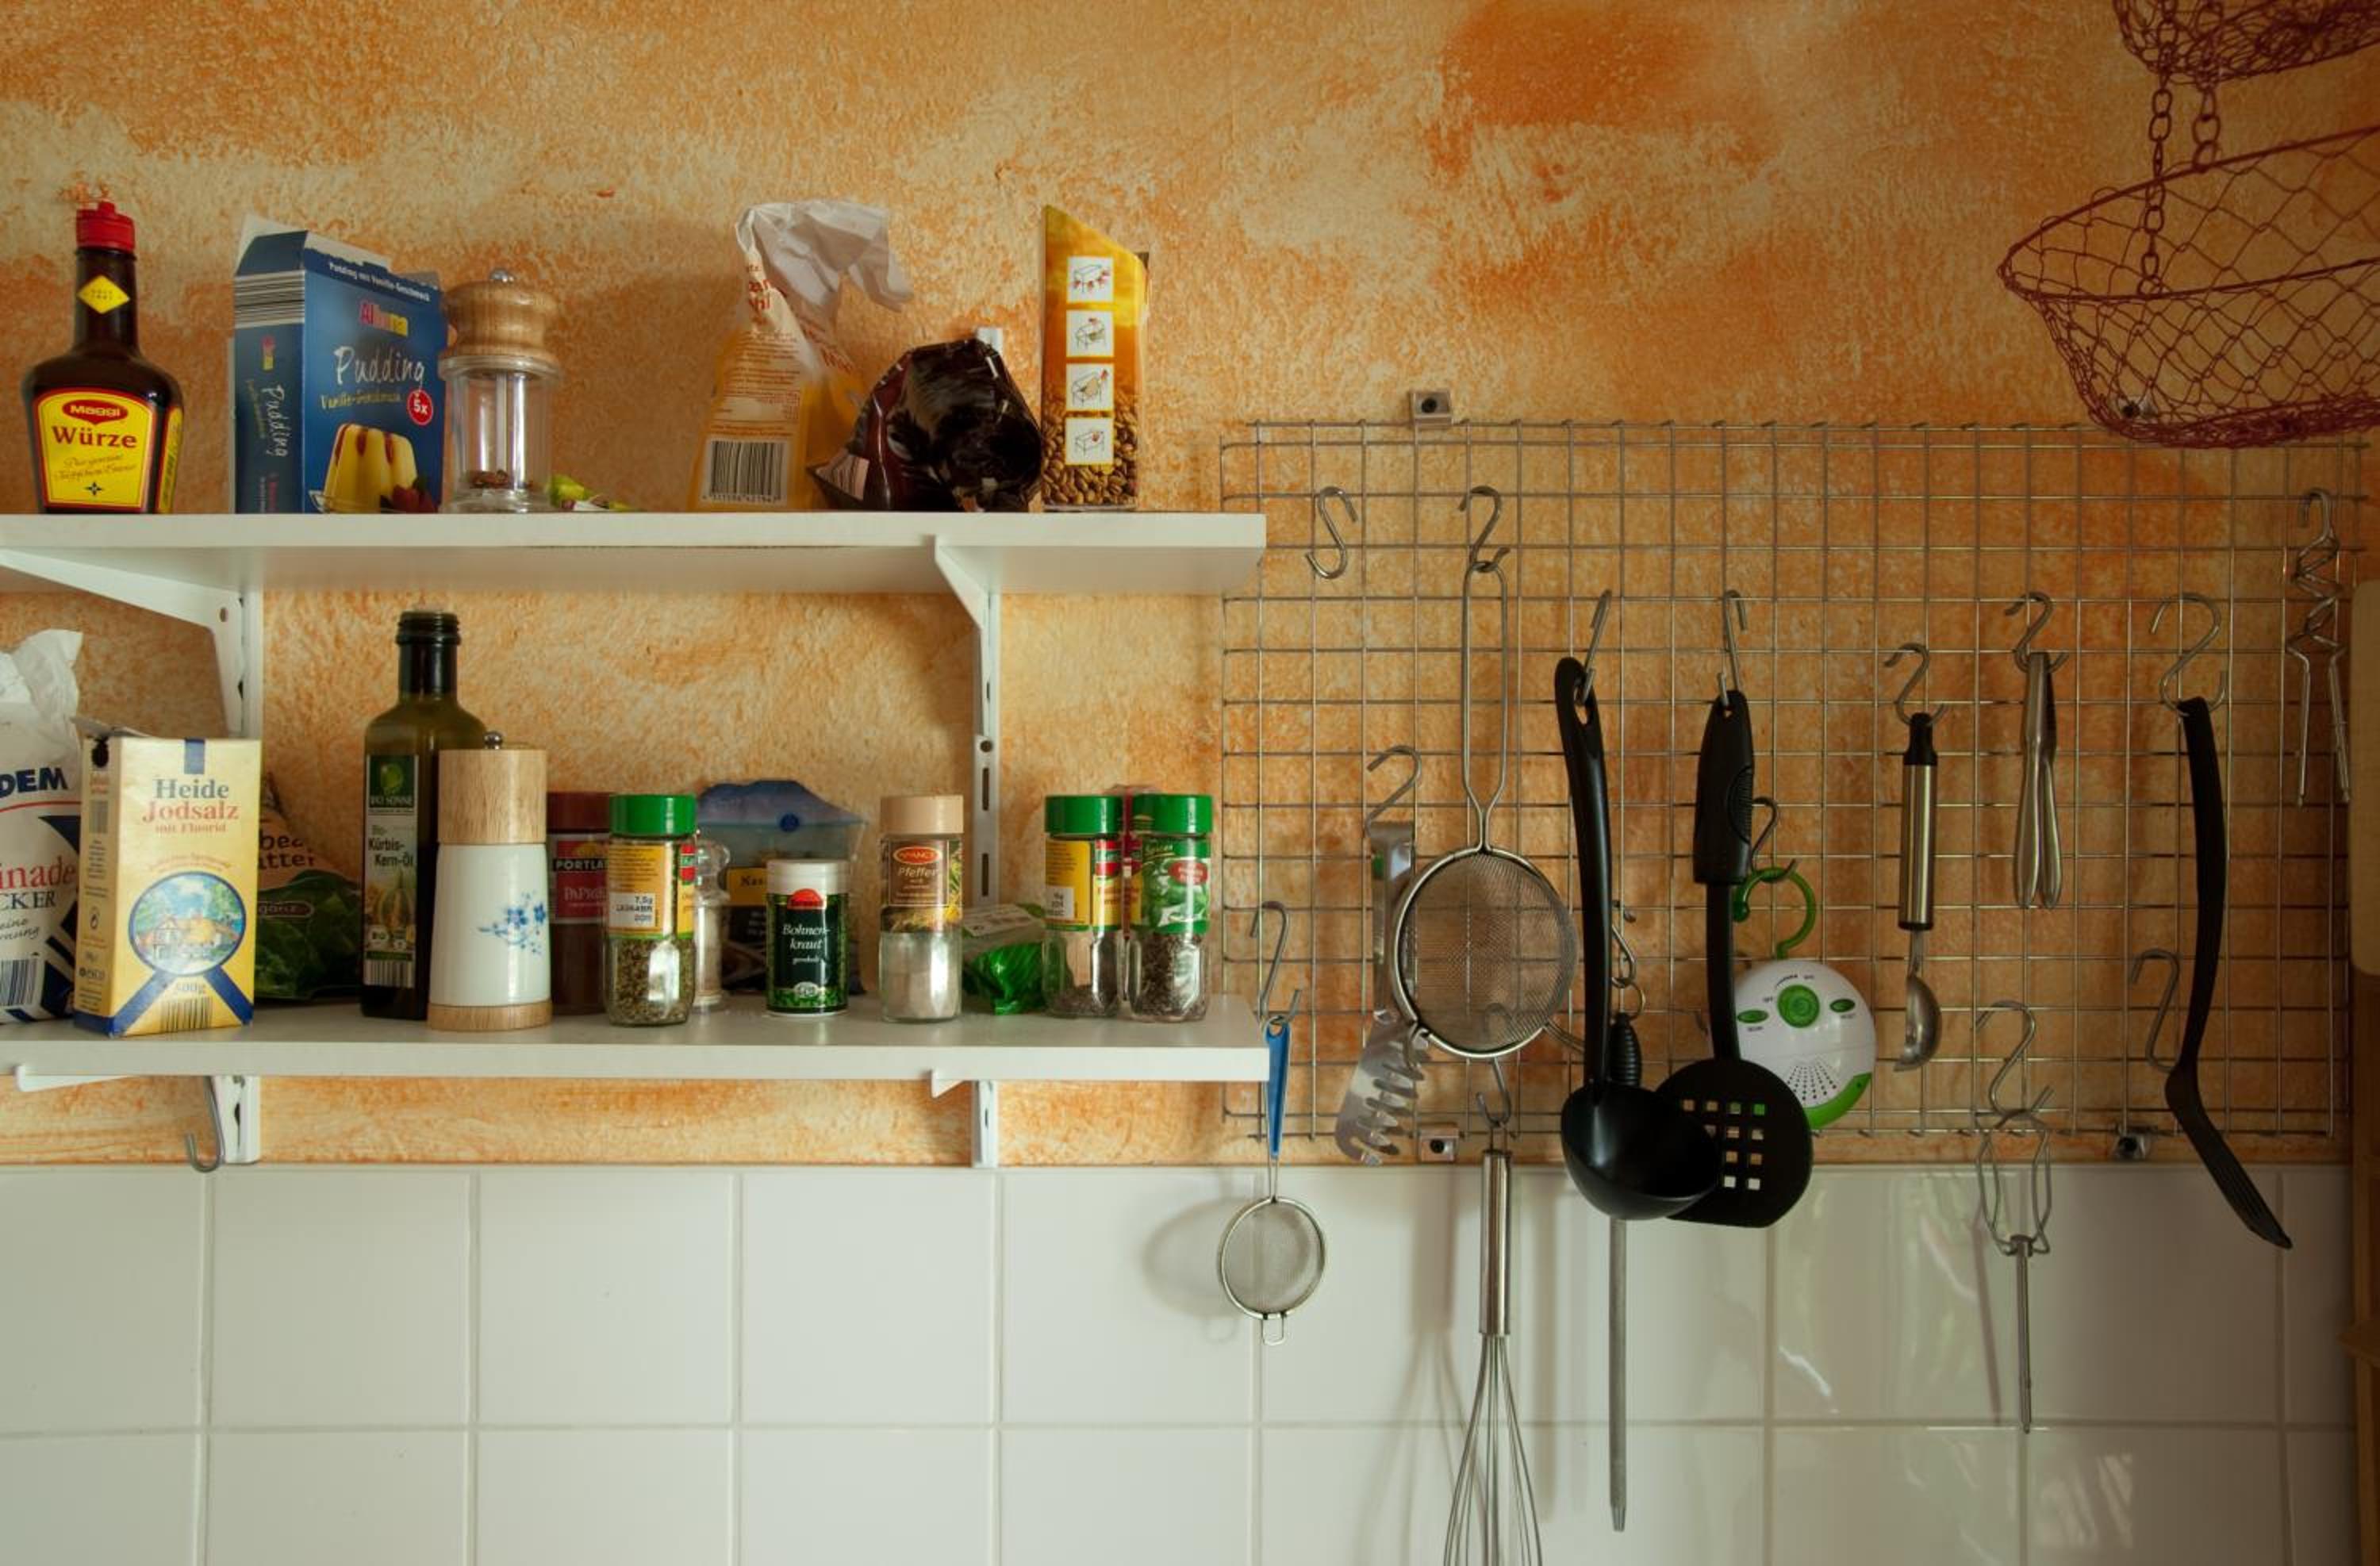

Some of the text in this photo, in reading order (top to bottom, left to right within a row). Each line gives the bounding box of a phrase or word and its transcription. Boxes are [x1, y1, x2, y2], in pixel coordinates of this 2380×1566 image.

[333, 346, 425, 389] Pudding
[412, 398, 429, 415] 5x
[52, 425, 137, 449] Würze
[153, 777, 229, 799] Heide
[142, 800, 240, 823] Jodsalz
[897, 866, 940, 877] Pfeffer
[782, 923, 831, 935] Bohnen-
[789, 938, 823, 950] kraut
